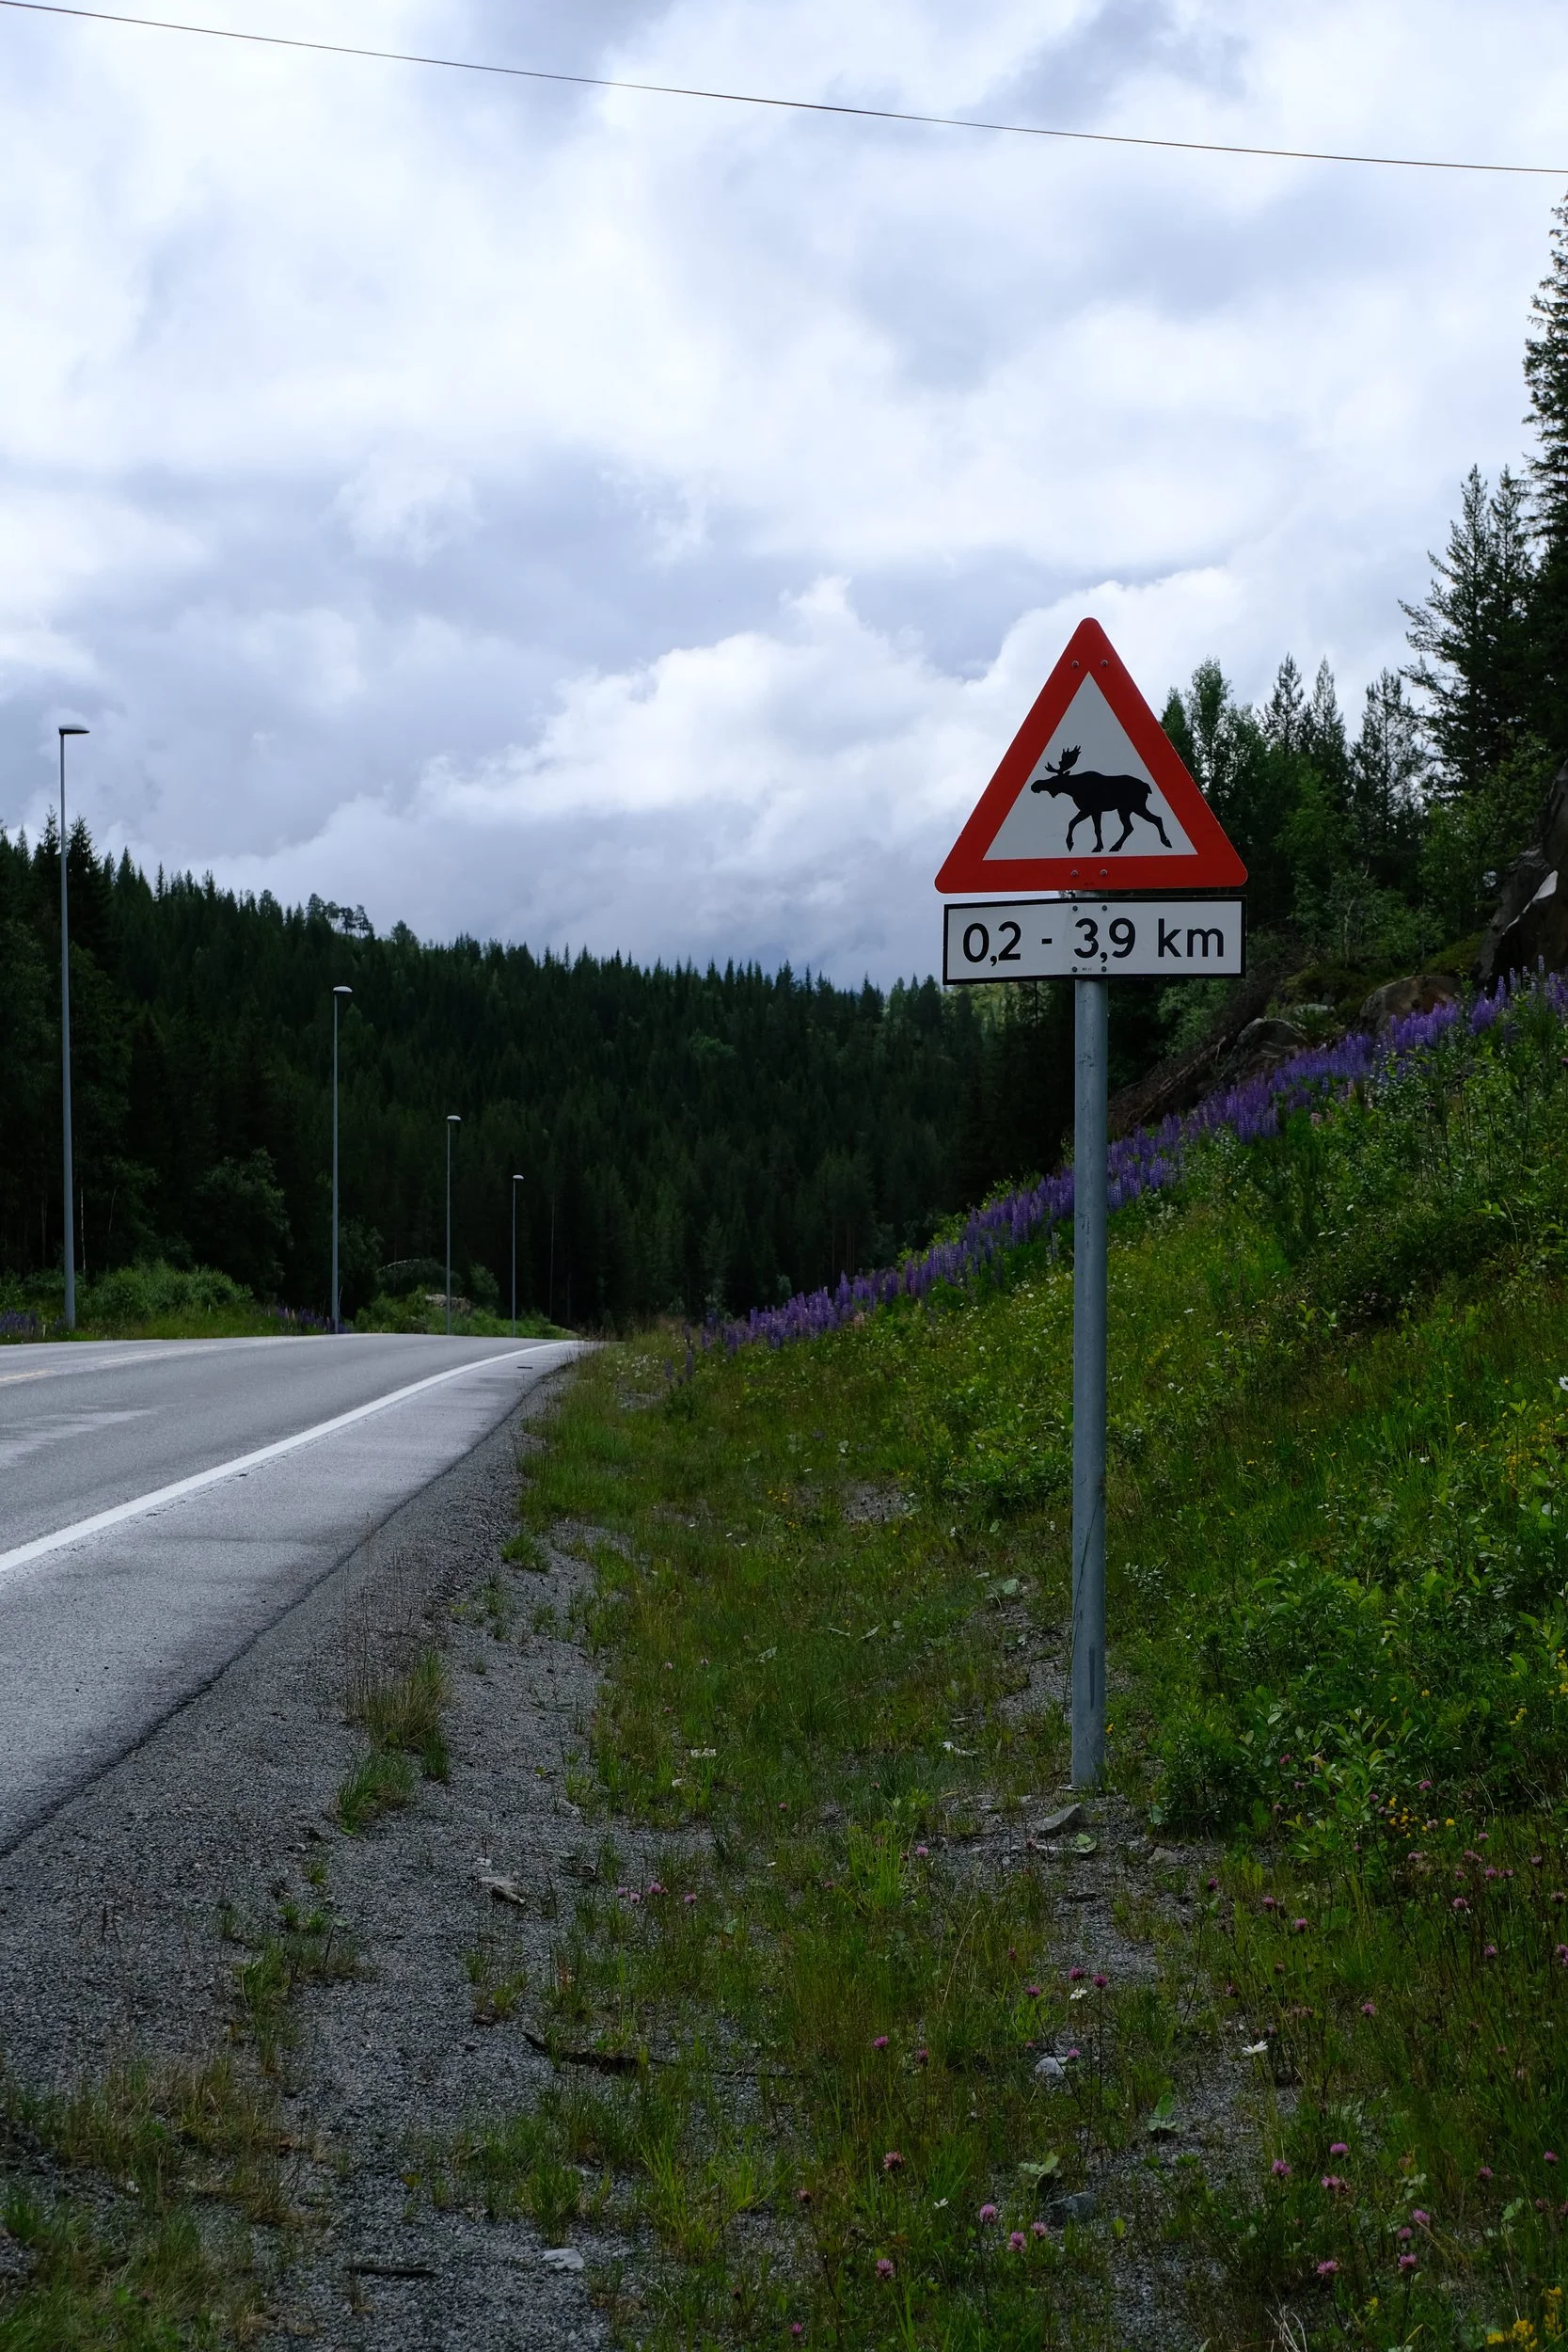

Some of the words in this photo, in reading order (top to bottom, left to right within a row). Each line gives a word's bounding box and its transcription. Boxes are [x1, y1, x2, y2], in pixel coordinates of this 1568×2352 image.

[963, 921, 1022, 967] 0,2
[1074, 917, 1136, 963] 3,9
[1158, 917, 1225, 958] km
